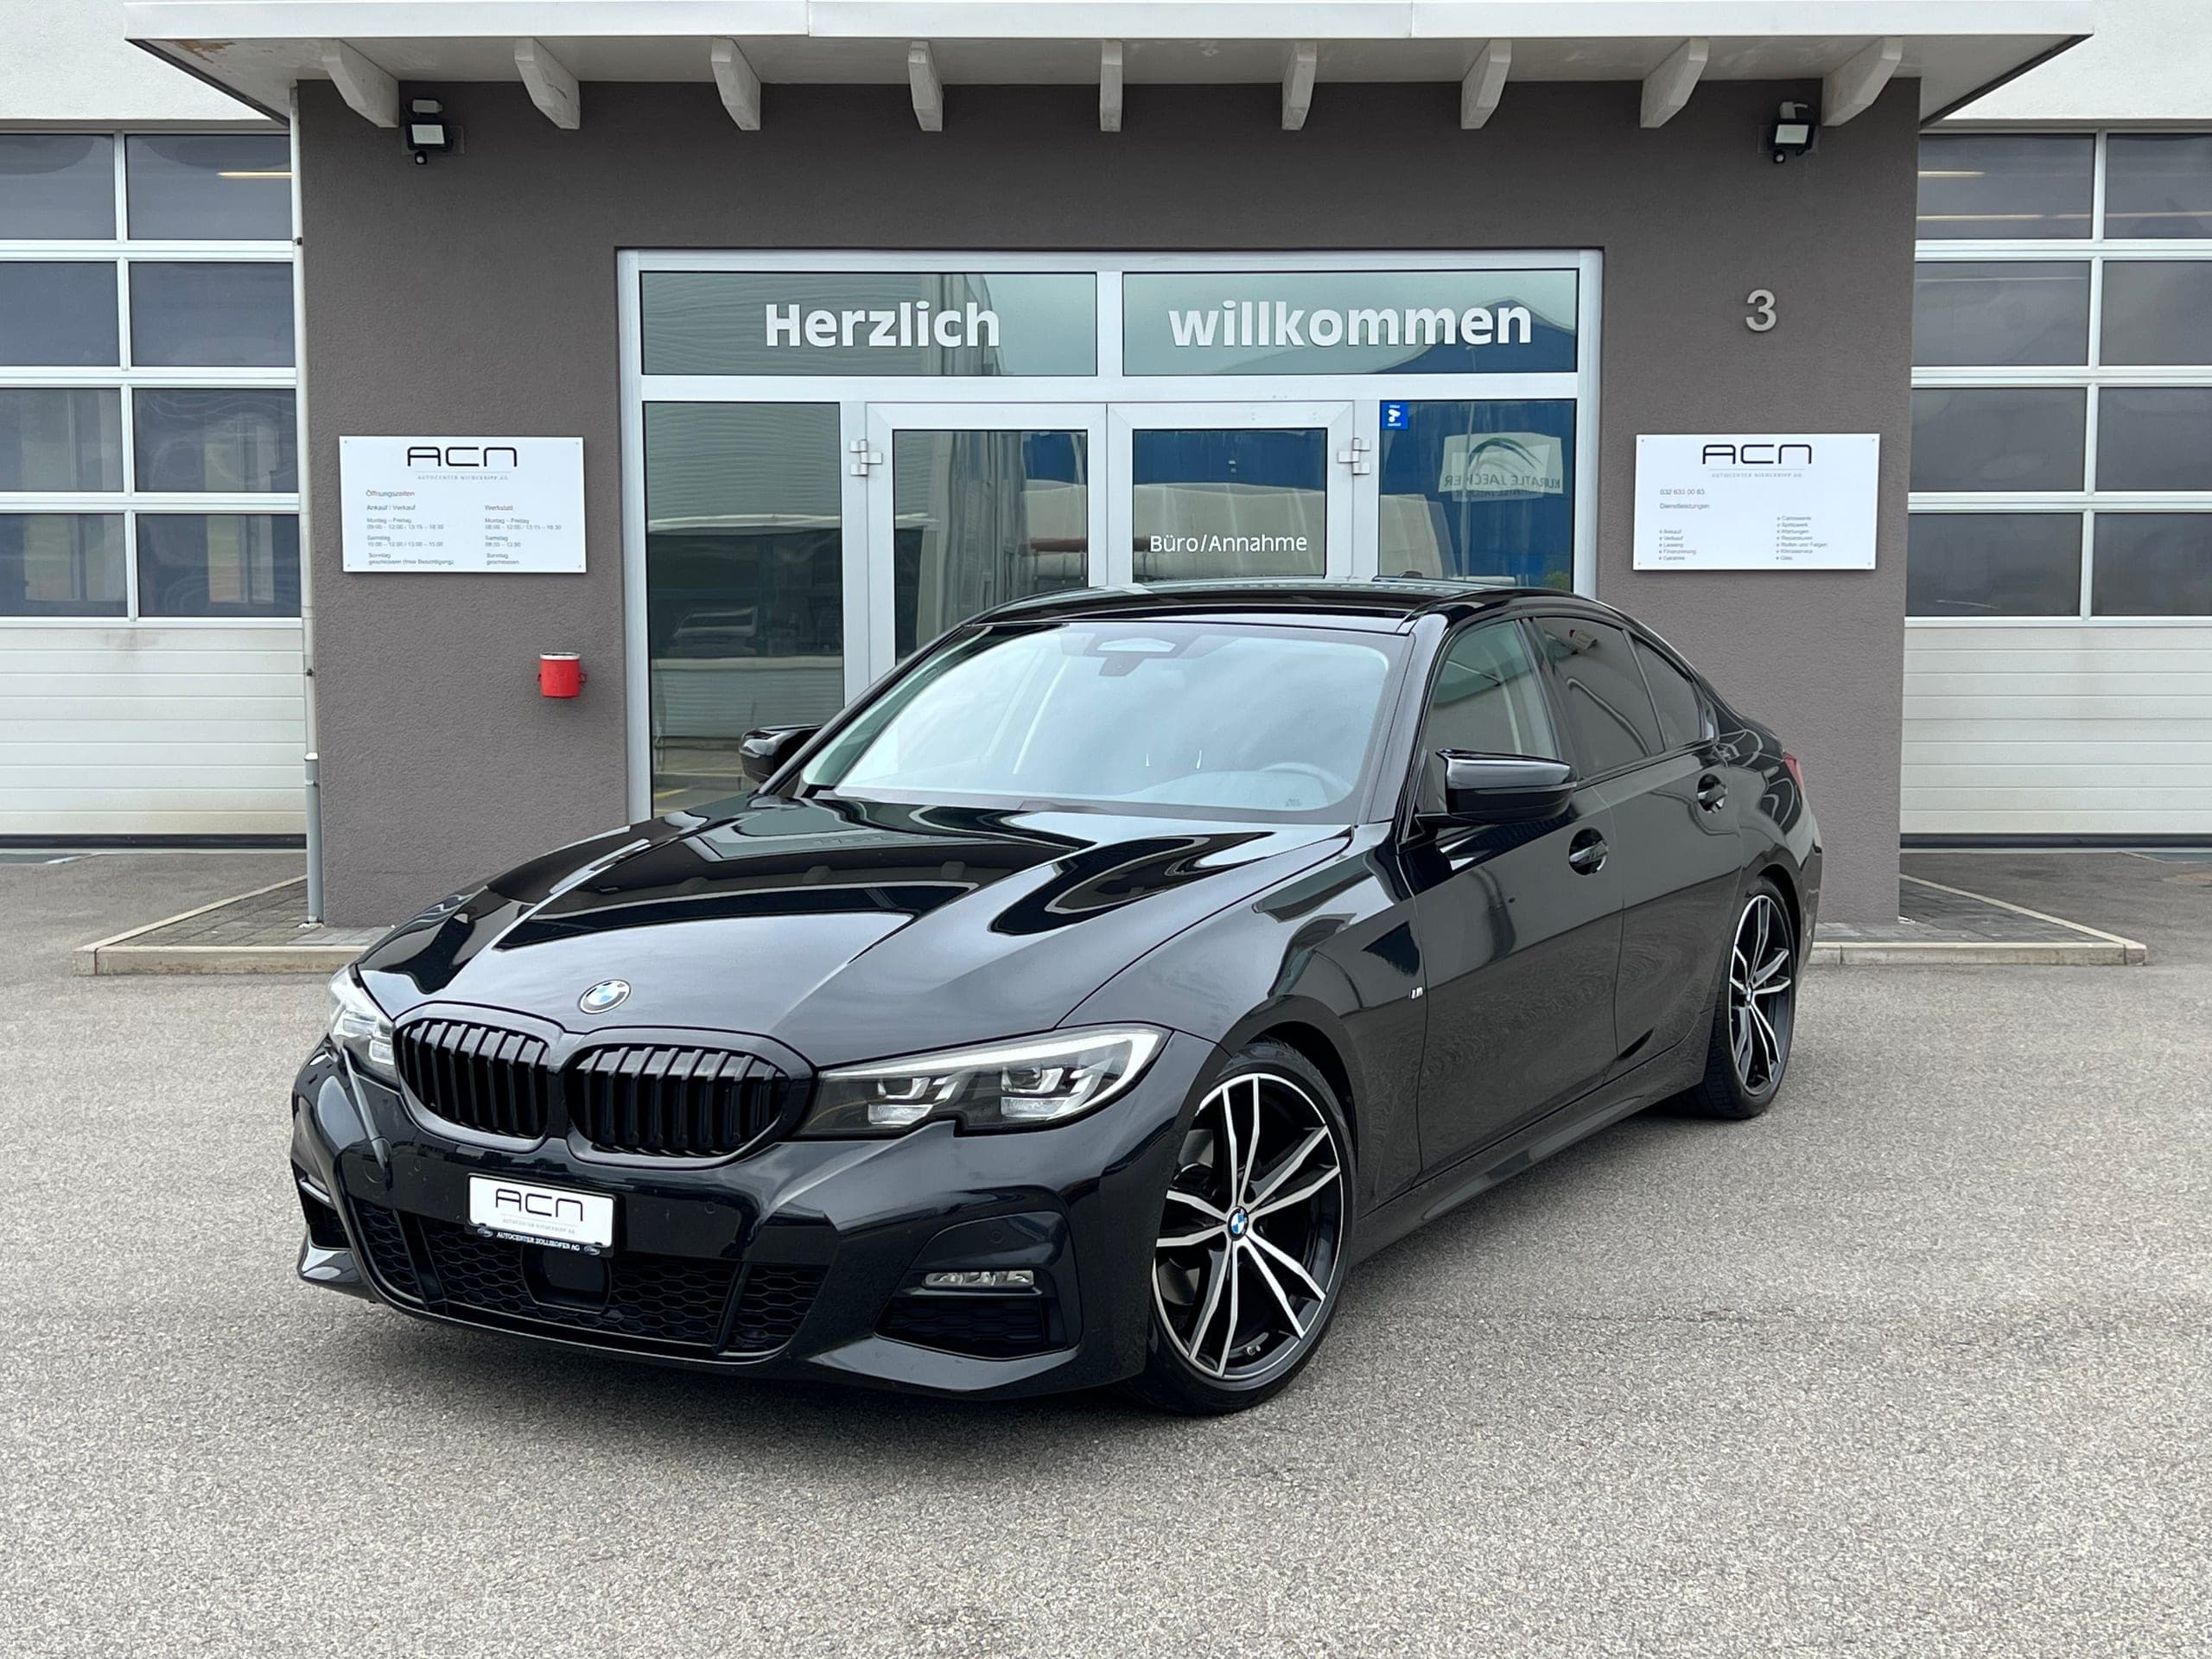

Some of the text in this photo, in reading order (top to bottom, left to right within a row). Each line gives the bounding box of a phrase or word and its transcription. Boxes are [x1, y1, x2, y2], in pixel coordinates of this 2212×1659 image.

[1745, 289, 1777, 332] 3
[765, 300, 1532, 347] Herzlich willkommen
[407, 446, 518, 467] ACN
[1701, 443, 1812, 465] ACN
[1150, 534, 1307, 553] Büro/Annahme
[495, 1188, 583, 1222] ACN
[497, 1231, 535, 1243] AUTOCENTER
[570, 1243, 581, 1252] AG
